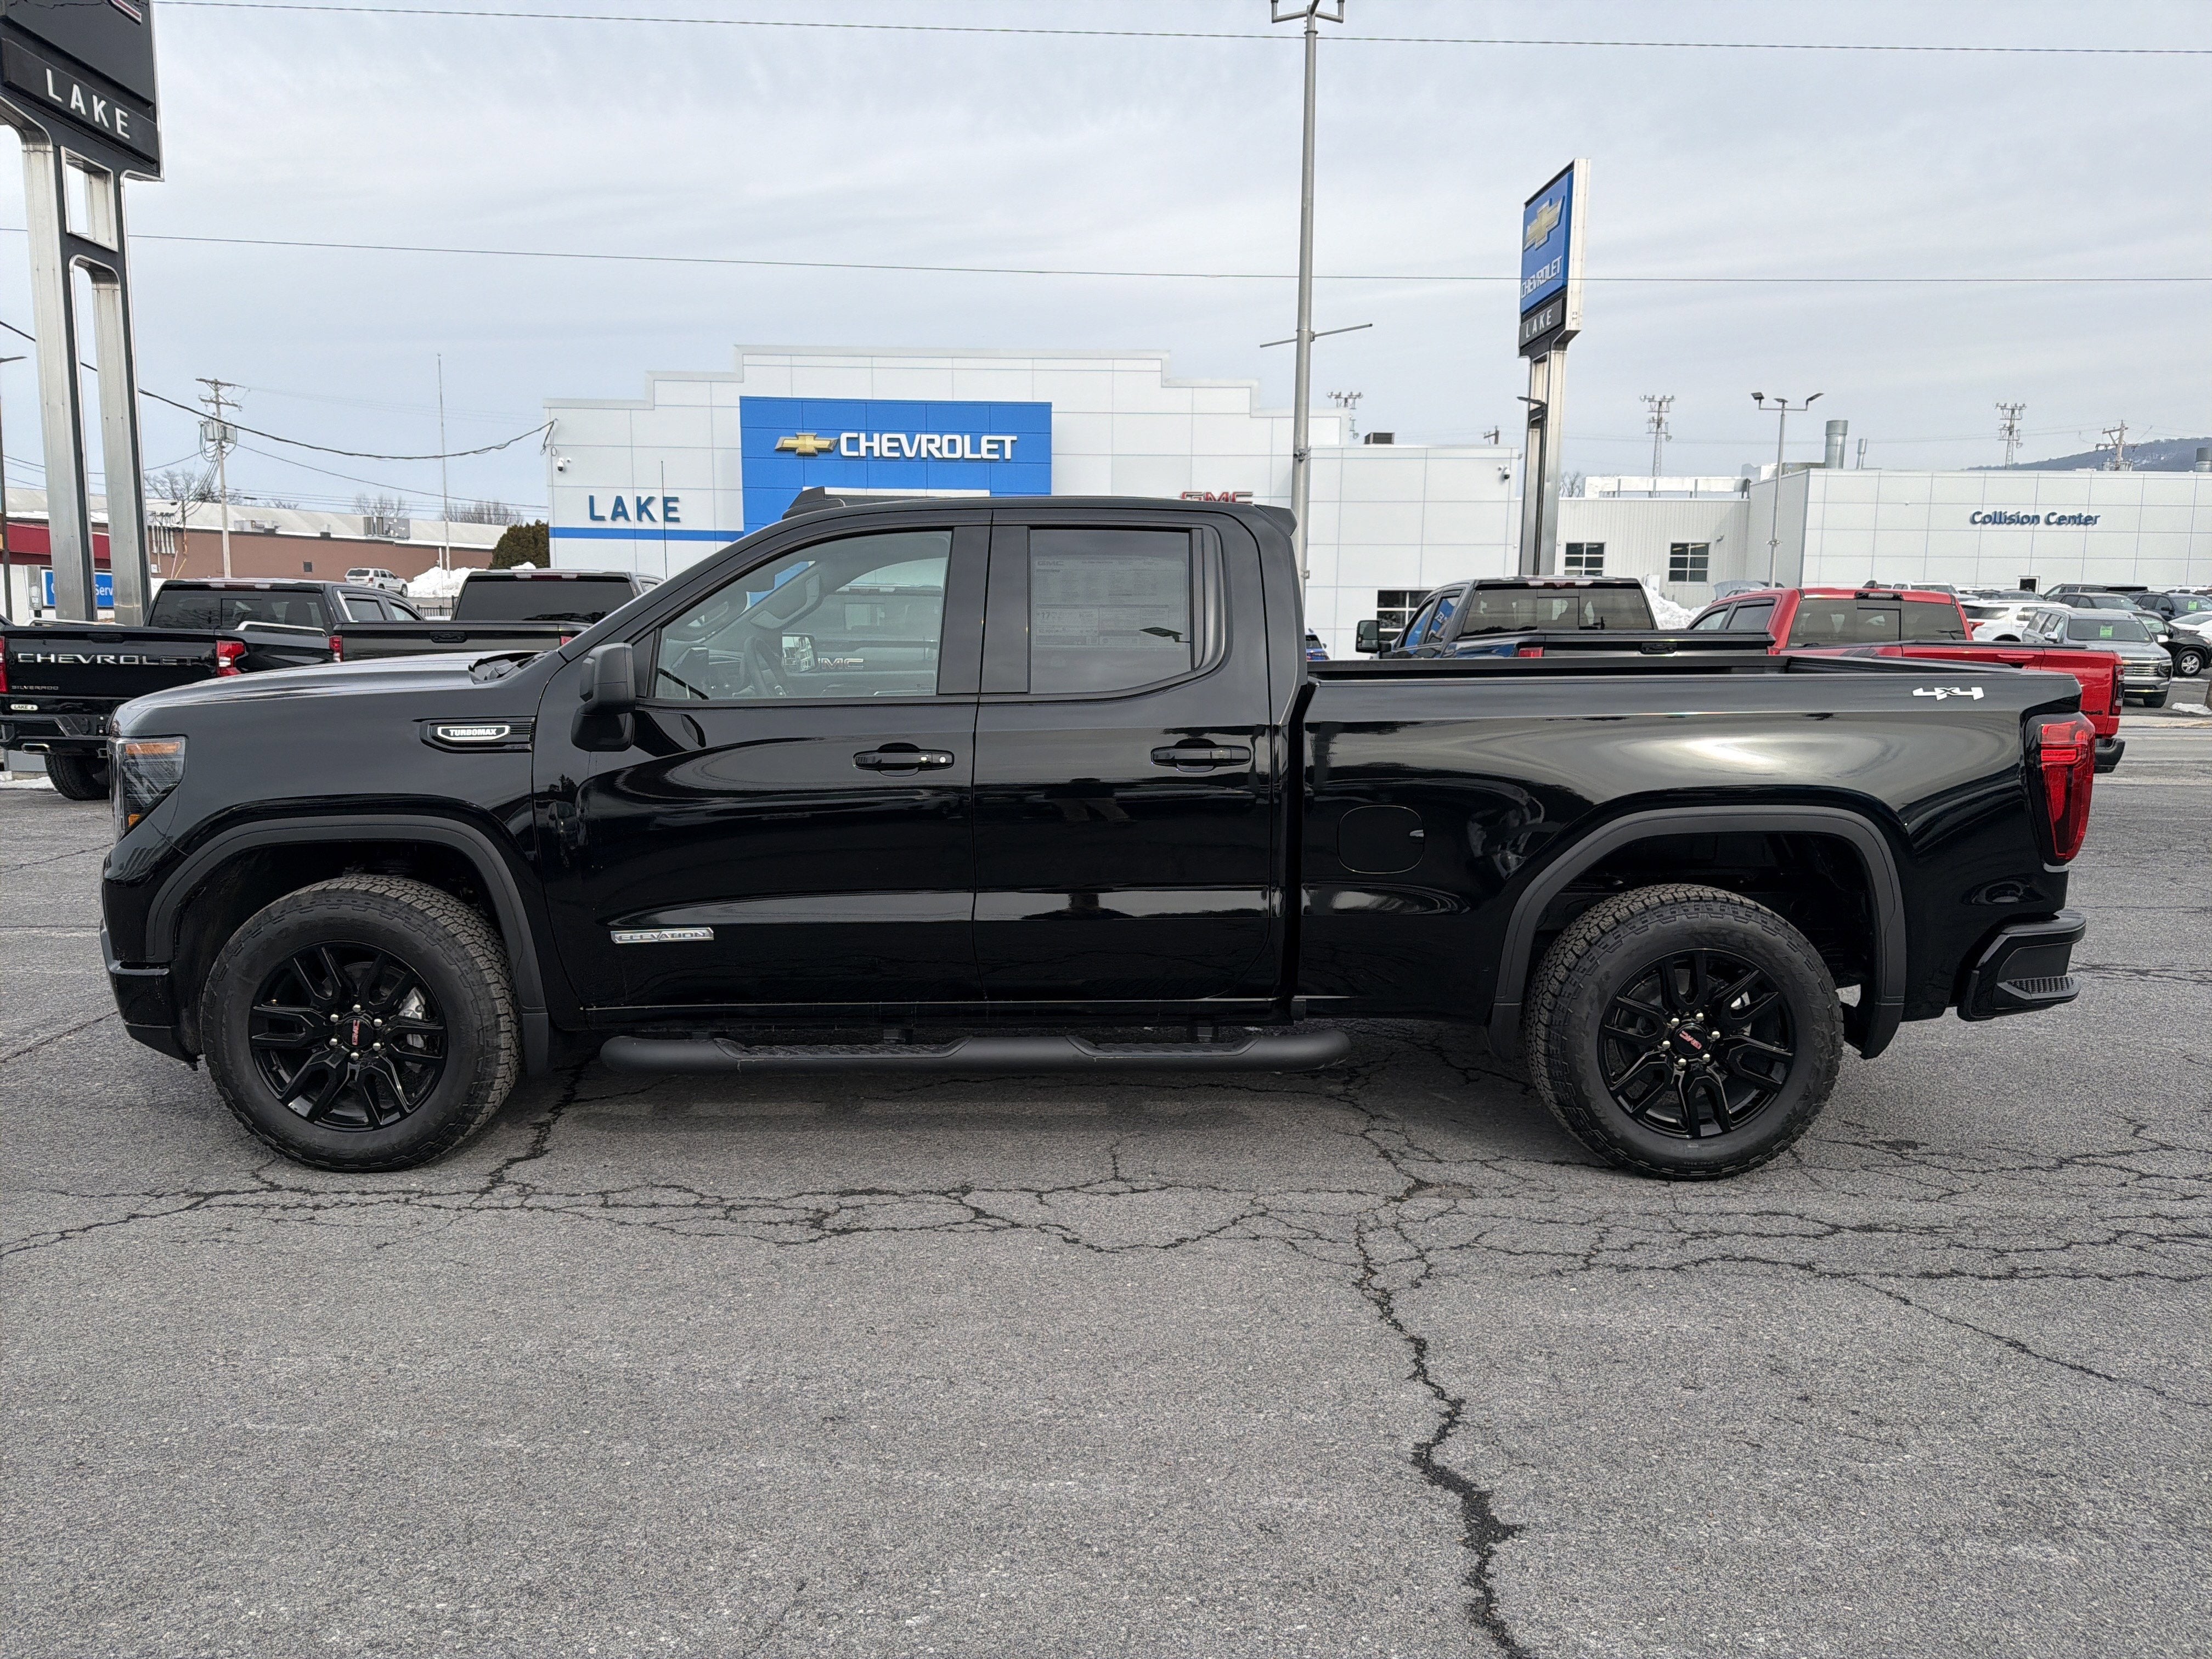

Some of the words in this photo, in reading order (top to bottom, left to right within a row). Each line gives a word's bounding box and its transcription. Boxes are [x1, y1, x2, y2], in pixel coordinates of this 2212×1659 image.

[46, 68, 131, 139] LAKE
[1521, 255, 1562, 299] CHEVROLET
[1526, 308, 1552, 338] LAKE
[839, 432, 1018, 460] CHEVROLET
[1181, 492, 1253, 504] GMC
[588, 494, 681, 523] LAKE
[1970, 511, 2040, 526] Collision
[2045, 512, 2101, 527] Center
[18, 653, 200, 666] CHEVROLET
[818, 658, 864, 669] MC
[449, 728, 496, 736] TURBOMAX
[619, 931, 706, 940] ELEVATION
[352, 1019, 360, 1046] GMC
[1679, 1030, 1703, 1050] GMC
